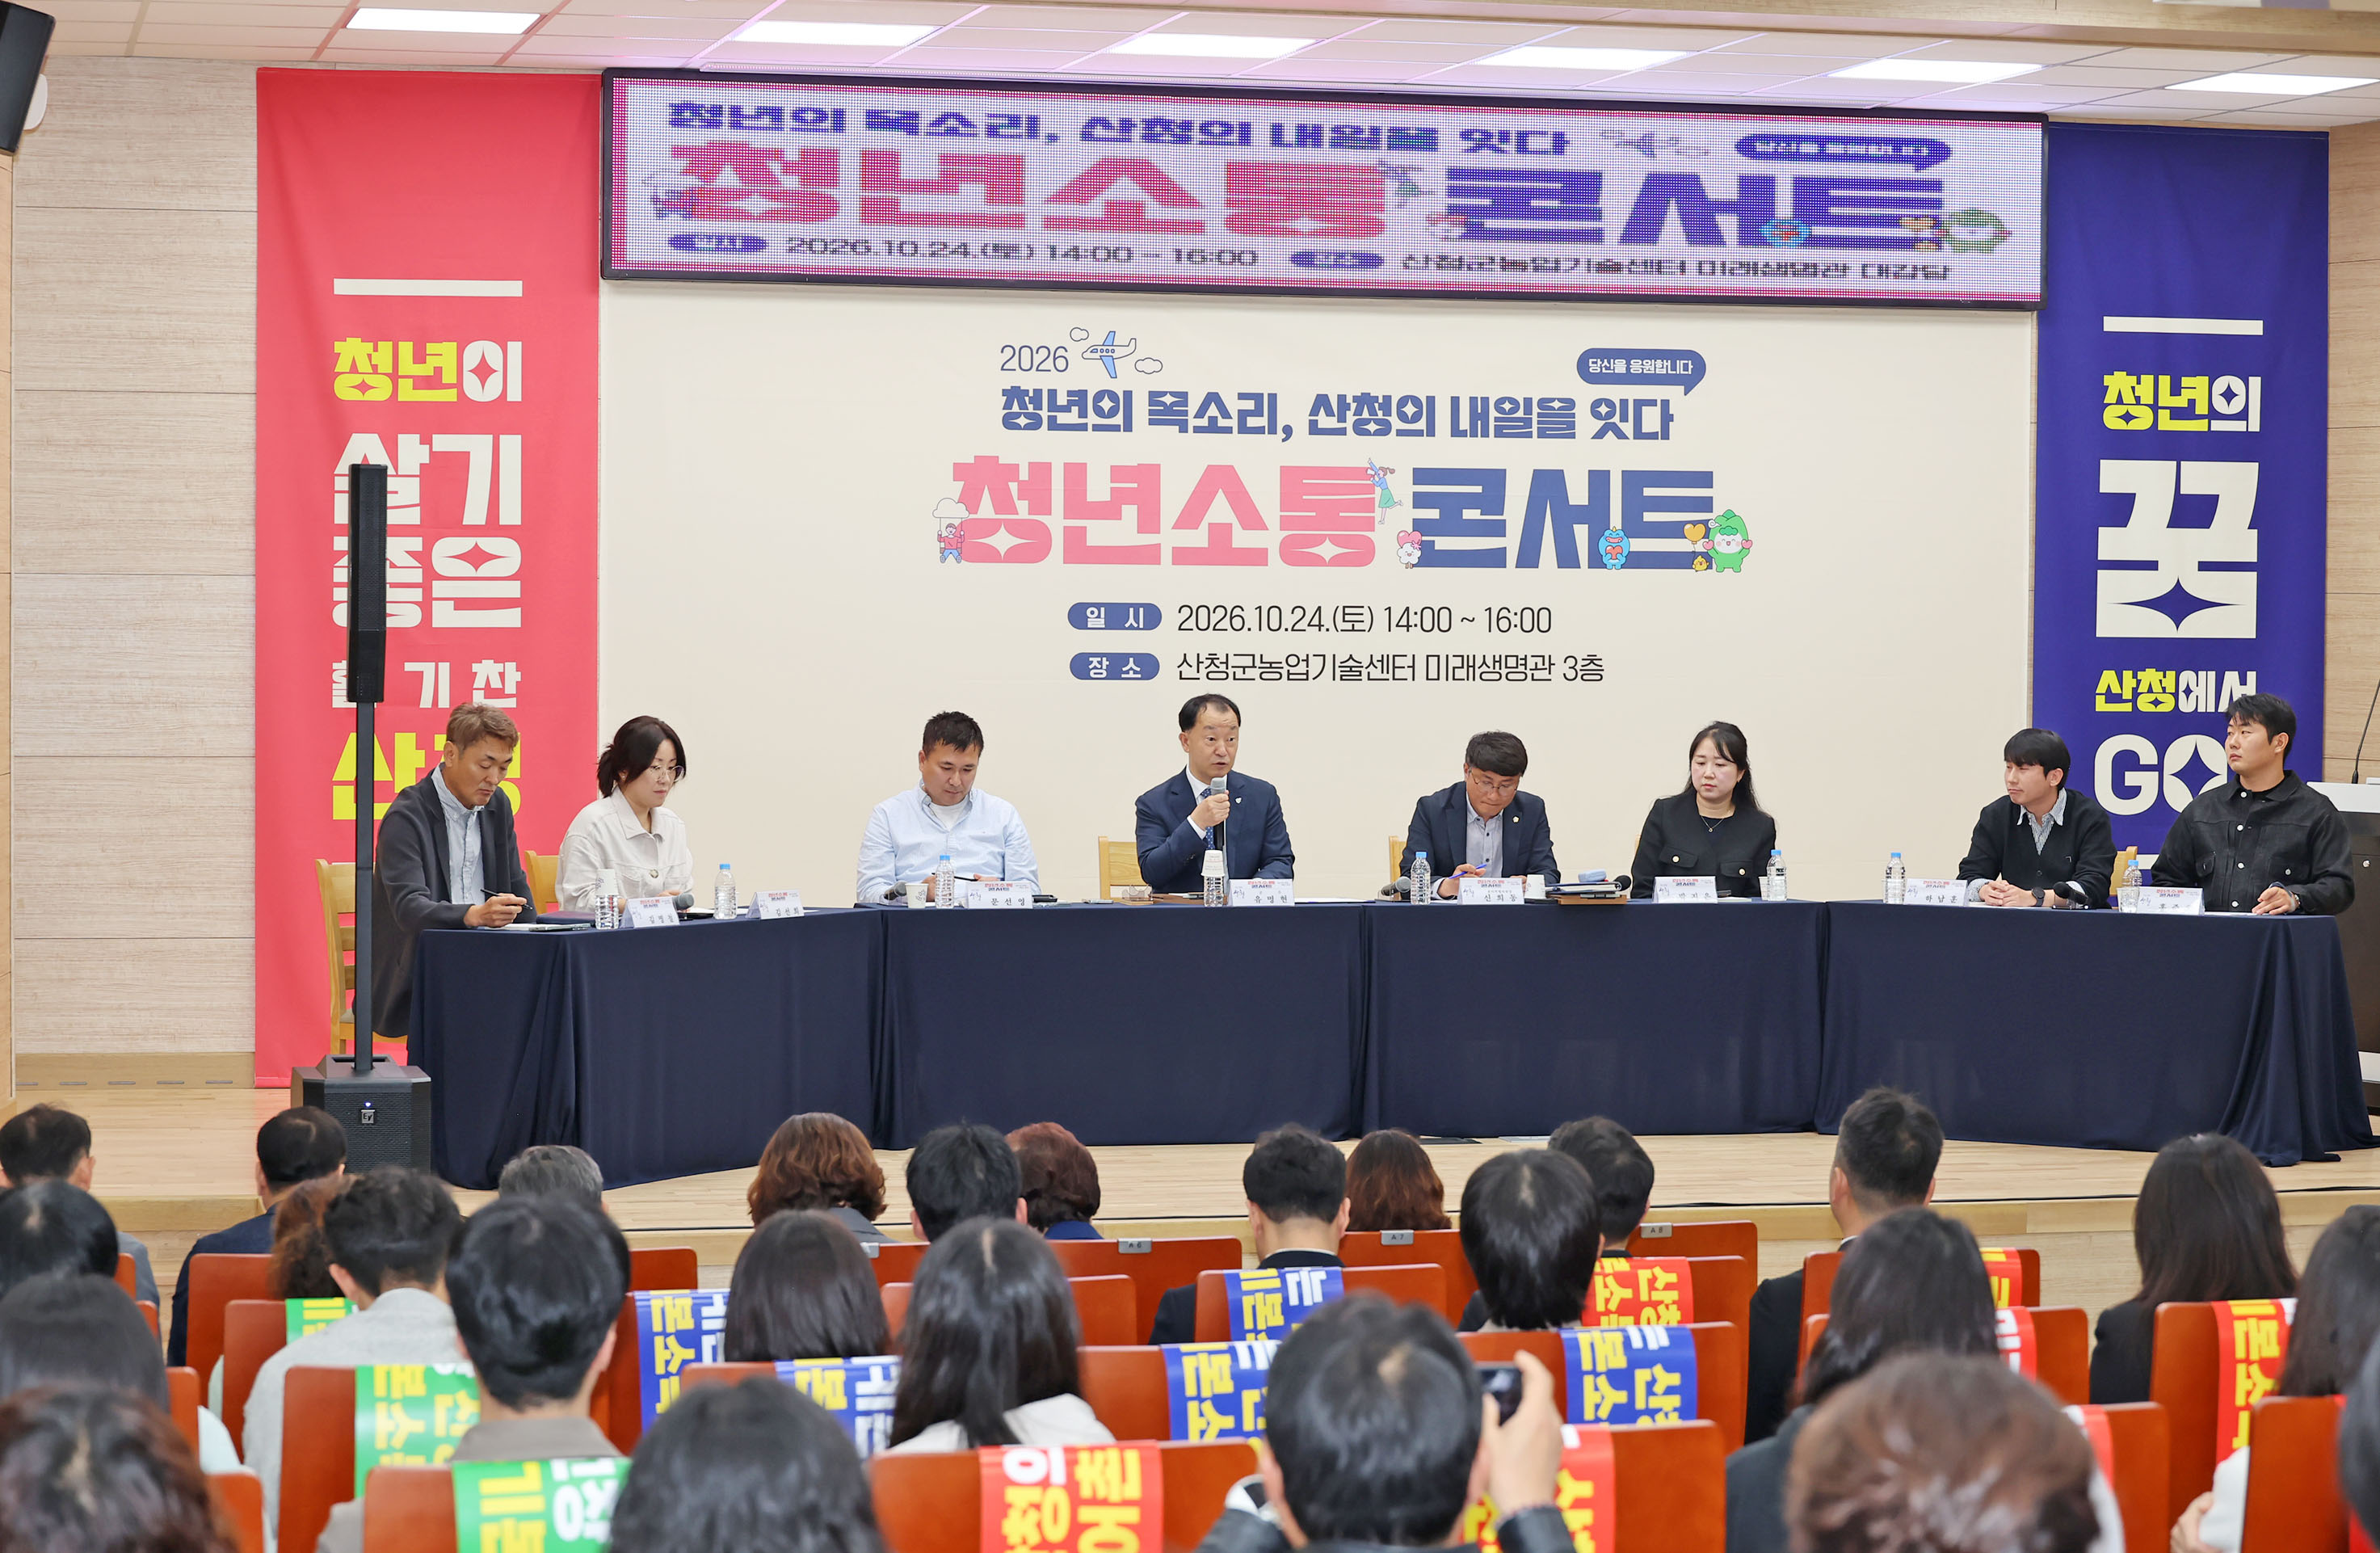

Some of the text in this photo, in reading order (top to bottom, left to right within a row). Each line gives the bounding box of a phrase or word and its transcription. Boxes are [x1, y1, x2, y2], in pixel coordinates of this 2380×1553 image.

[669, 102, 846, 133] 청년의
[1079, 116, 1251, 147] 산청의
[1270, 120, 1438, 152] 내일을
[1460, 127, 1571, 156] 잇다
[671, 140, 1943, 250] 청년소통 콘서트
[1048, 244, 1133, 264] 14:00
[1173, 247, 1258, 267] 16:00
[334, 337, 522, 402] 청년이
[1000, 345, 1069, 372] 2026
[1589, 358, 1693, 375] 당신을 응원합니다
[1002, 386, 1674, 442] 청년의 목소리, 산청의 내일을 잇다
[2103, 371, 2261, 431] 청년의
[953, 455, 1714, 569] 청년소통 콘서트
[2096, 460, 2259, 638] 꿈
[1177, 604, 1373, 633] 2026.10.24.(토)
[1384, 606, 1452, 633] 14:00
[1484, 606, 1552, 633] 16:00
[1177, 652, 1604, 682] 산청군농업기술센터 미래생명관 3층
